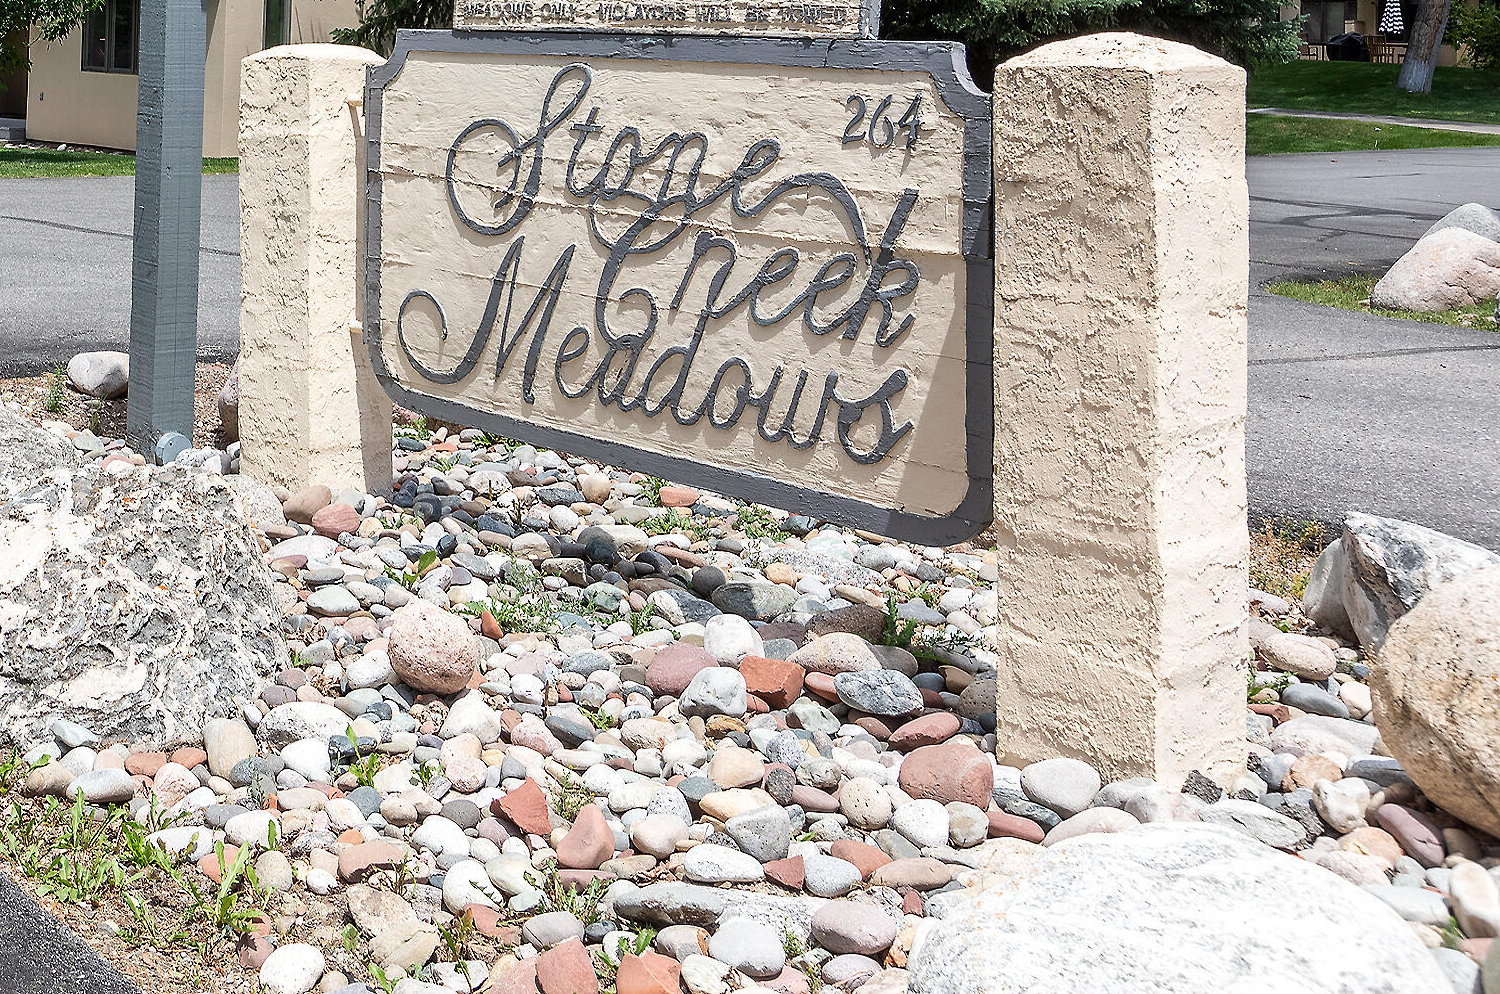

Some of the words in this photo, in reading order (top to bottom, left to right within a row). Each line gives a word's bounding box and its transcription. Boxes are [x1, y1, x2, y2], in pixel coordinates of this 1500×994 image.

[445, 62, 872, 266] Stone
[842, 94, 922, 149] 264
[399, 235, 915, 465] Meadows
[588, 189, 922, 350] Creek
